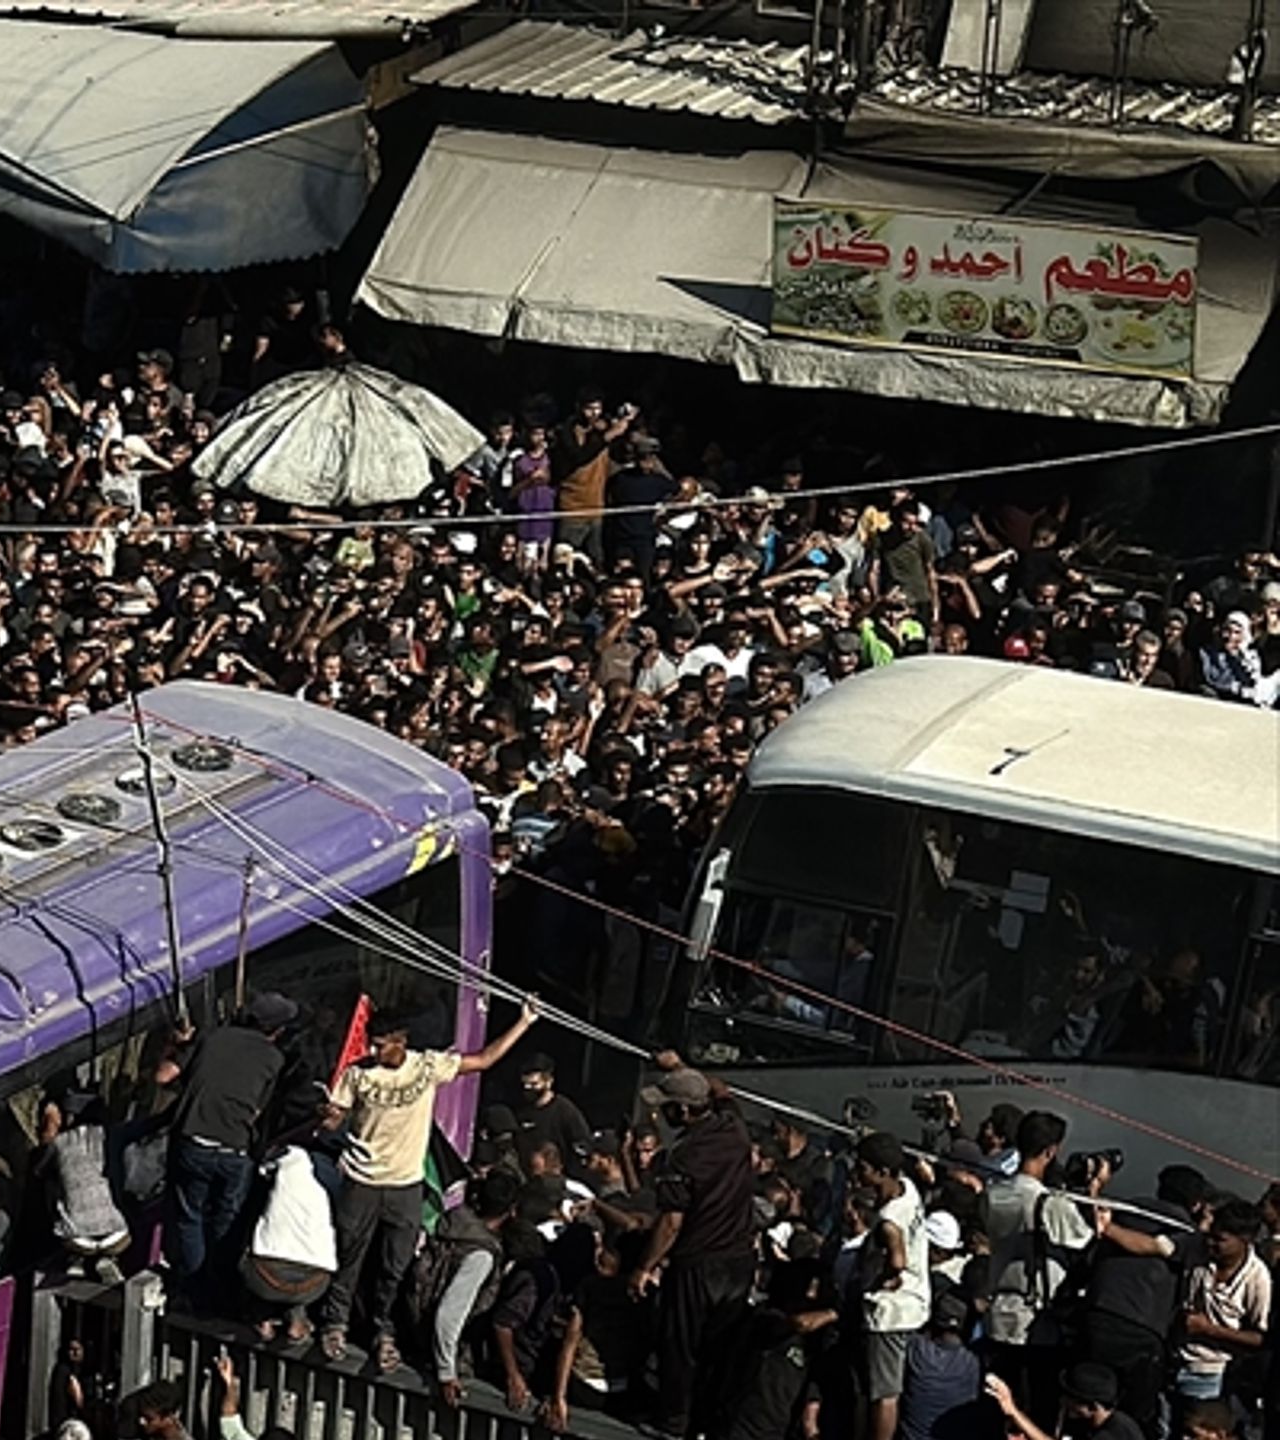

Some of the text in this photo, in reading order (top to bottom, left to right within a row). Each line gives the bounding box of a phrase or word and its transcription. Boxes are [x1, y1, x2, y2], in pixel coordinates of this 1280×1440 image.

[786, 224, 891, 268] كنان
[901, 243, 920, 284] و
[1044, 241, 1196, 305] مطعم
